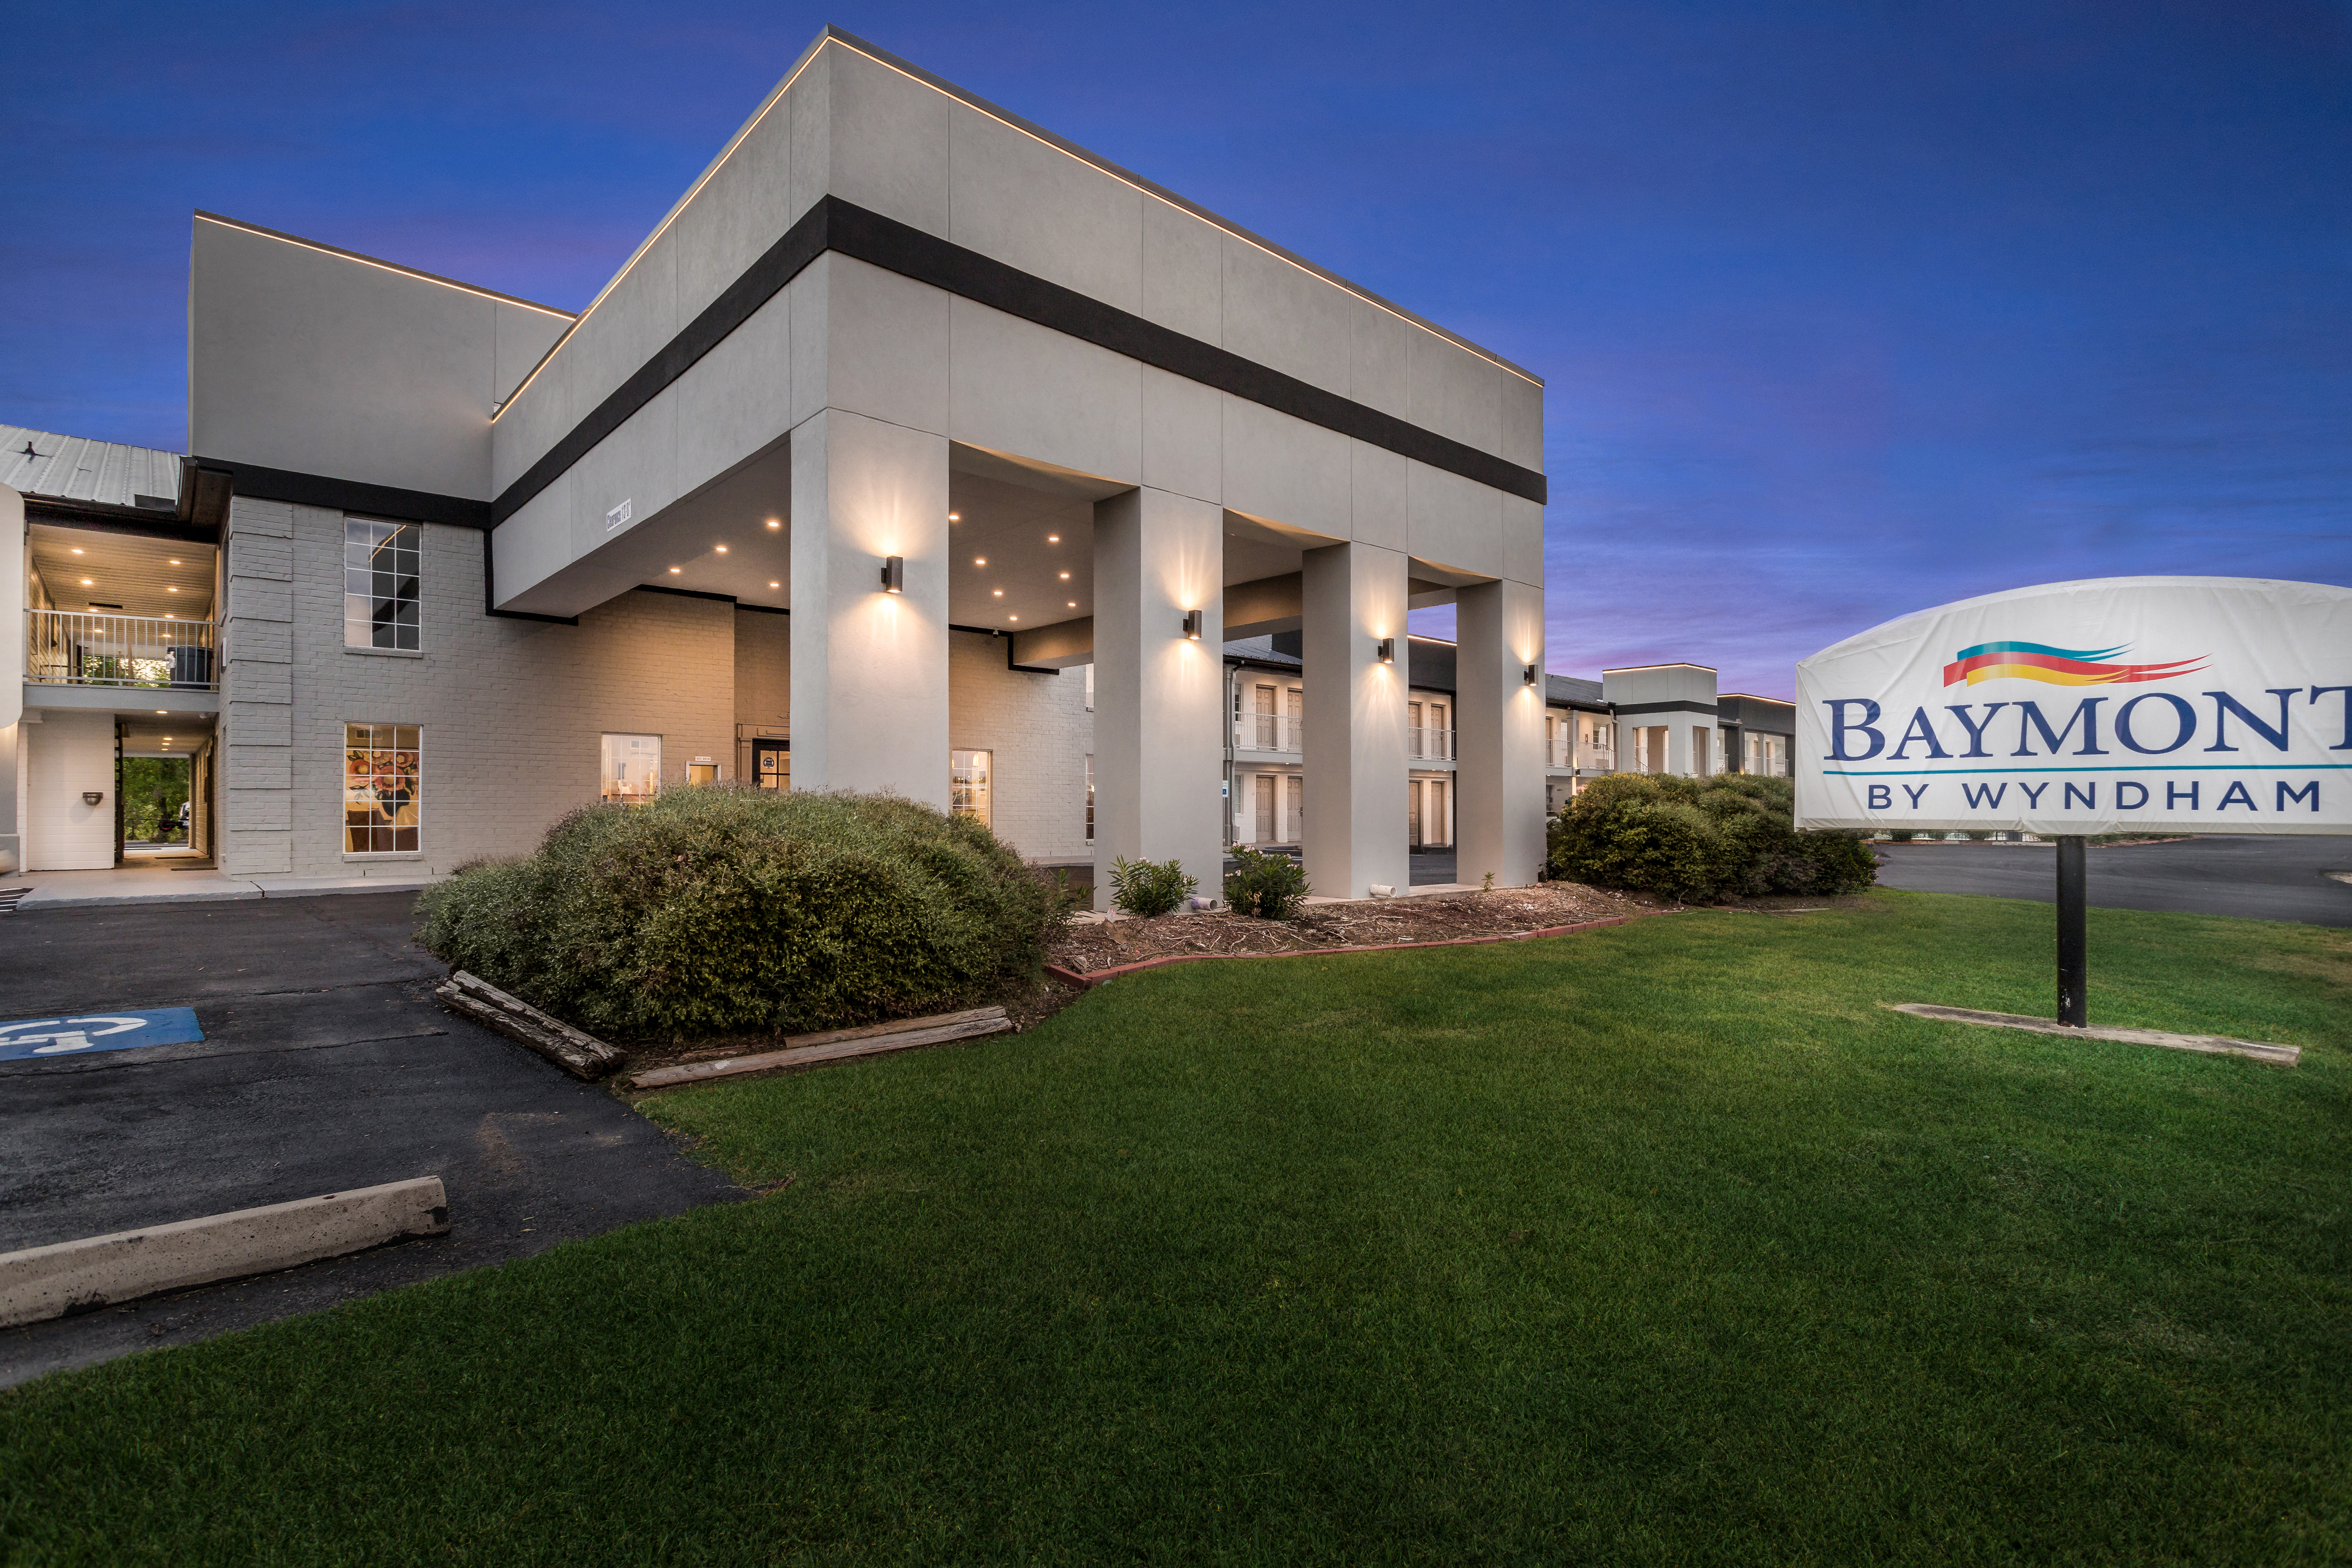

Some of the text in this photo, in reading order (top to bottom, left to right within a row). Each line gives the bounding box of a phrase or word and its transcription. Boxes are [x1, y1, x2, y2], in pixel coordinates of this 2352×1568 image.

[1822, 685, 2352, 761] BAYMONT
[1868, 781, 2319, 812] BY WYNDHAM
